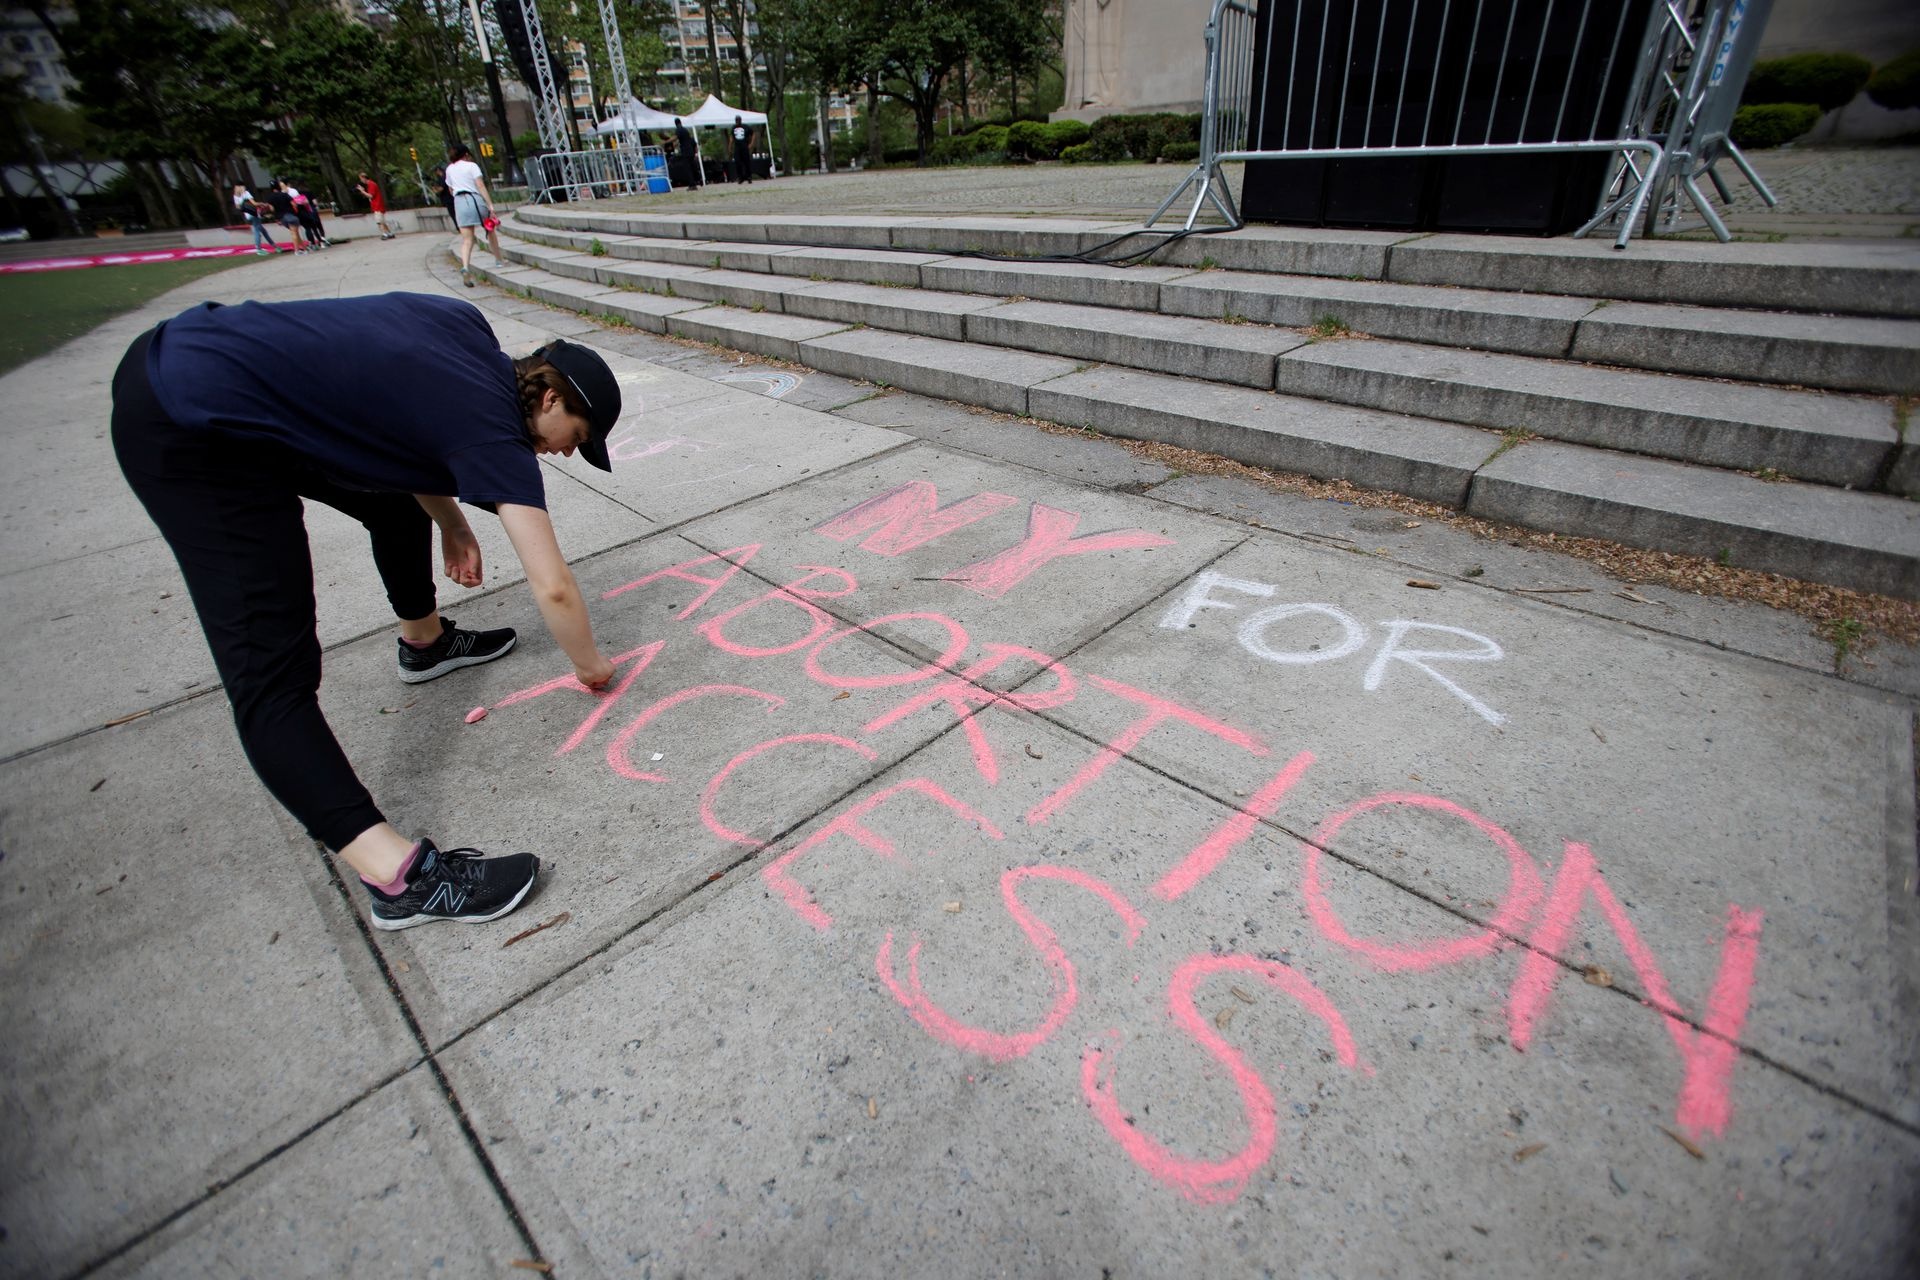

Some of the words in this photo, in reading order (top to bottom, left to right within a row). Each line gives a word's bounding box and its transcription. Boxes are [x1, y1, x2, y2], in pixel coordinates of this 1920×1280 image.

[812, 480, 1178, 598] MY
[1158, 571, 1511, 726] FOR
[495, 640, 1372, 1203] ACCESS
[602, 543, 1764, 1141] ABORTION
